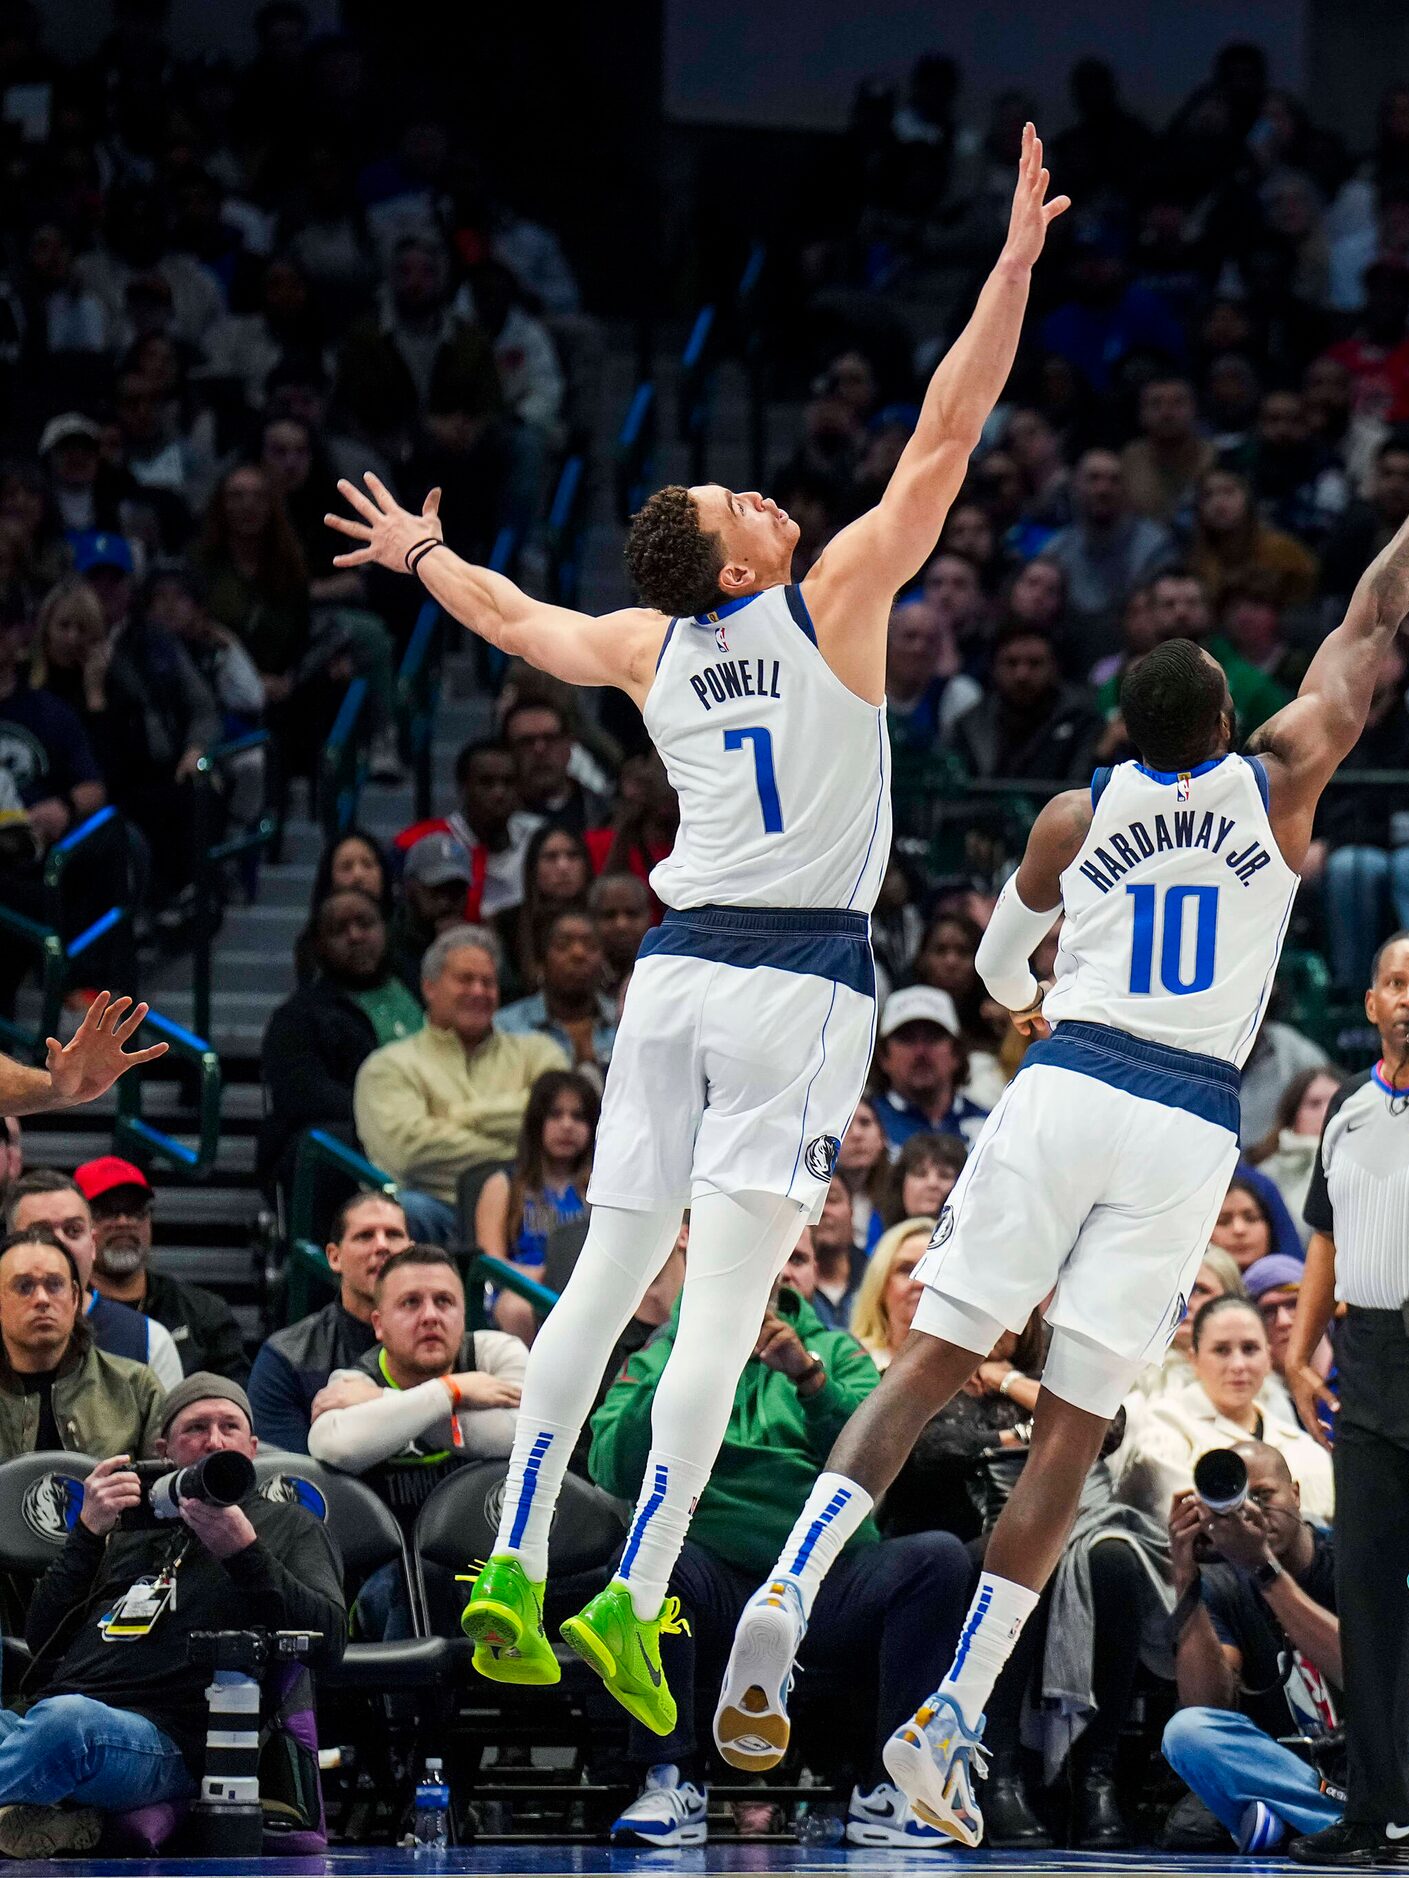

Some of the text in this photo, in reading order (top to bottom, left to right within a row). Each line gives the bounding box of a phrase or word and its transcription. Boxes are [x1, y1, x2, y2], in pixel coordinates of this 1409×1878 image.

[689, 659, 781, 711] POWELL
[723, 726, 784, 834] 7
[1079, 810, 1271, 894] HARDAWAY JR.
[1125, 883, 1220, 997] 10
